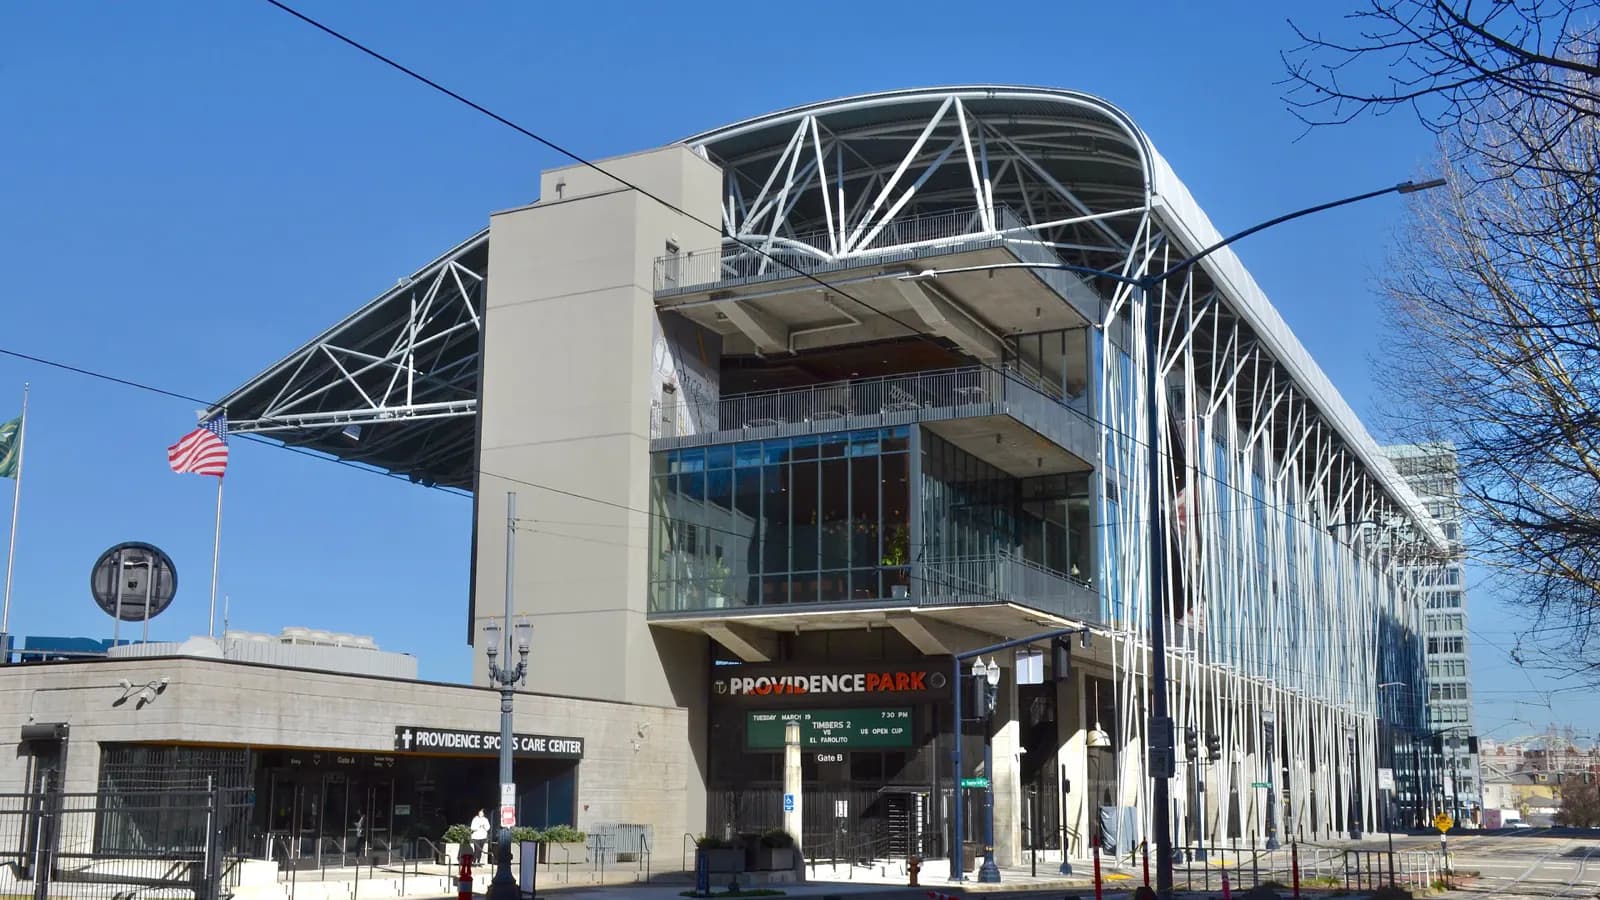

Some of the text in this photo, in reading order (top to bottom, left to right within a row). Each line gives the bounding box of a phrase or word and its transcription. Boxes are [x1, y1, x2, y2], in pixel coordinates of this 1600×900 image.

[881, 711, 895, 719] 730
[812, 720, 852, 729] TIMBERS 2
[891, 727, 904, 735] CUP
[415, 731, 582, 754] PROVIDENCE SPOS CARE CENTER
[809, 736, 848, 744] EL FAROLITO
[817, 753, 843, 762] Gate B
